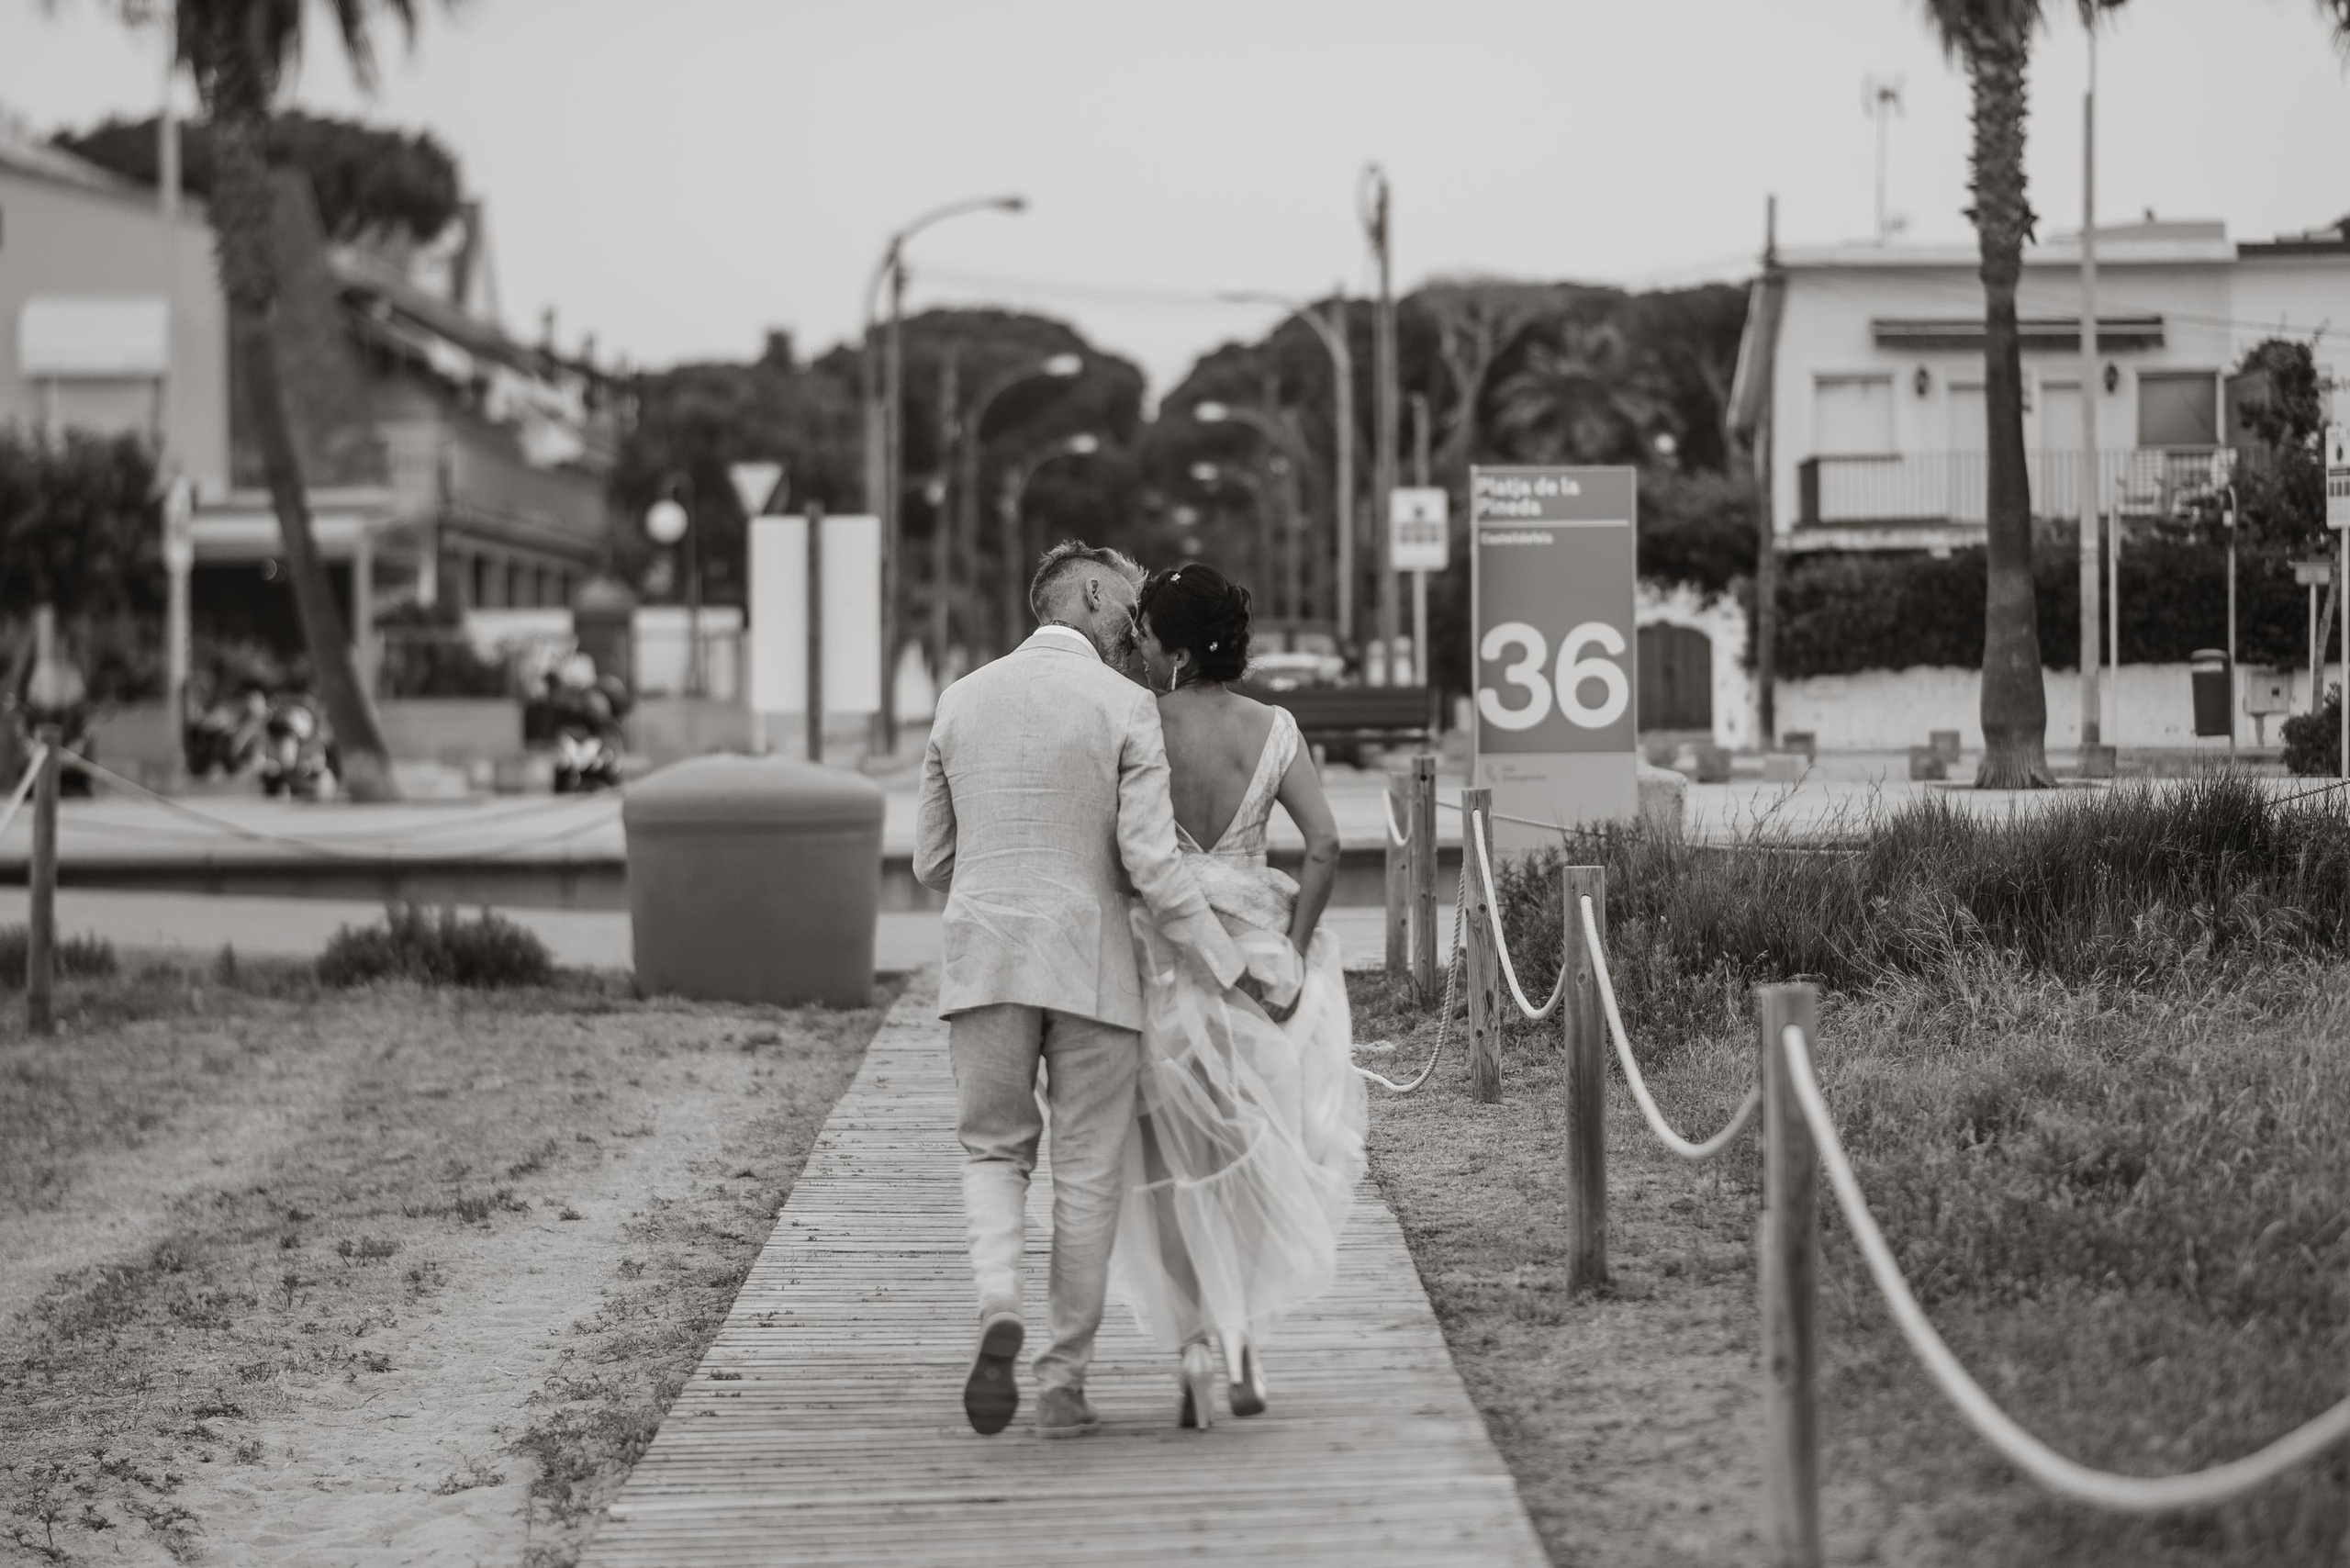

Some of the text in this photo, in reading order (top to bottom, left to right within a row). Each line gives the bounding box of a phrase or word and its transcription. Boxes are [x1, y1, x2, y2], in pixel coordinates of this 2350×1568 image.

[1533, 476, 1559, 496] de
[1560, 476, 1580, 496] la
[1479, 622, 1629, 730] 36
